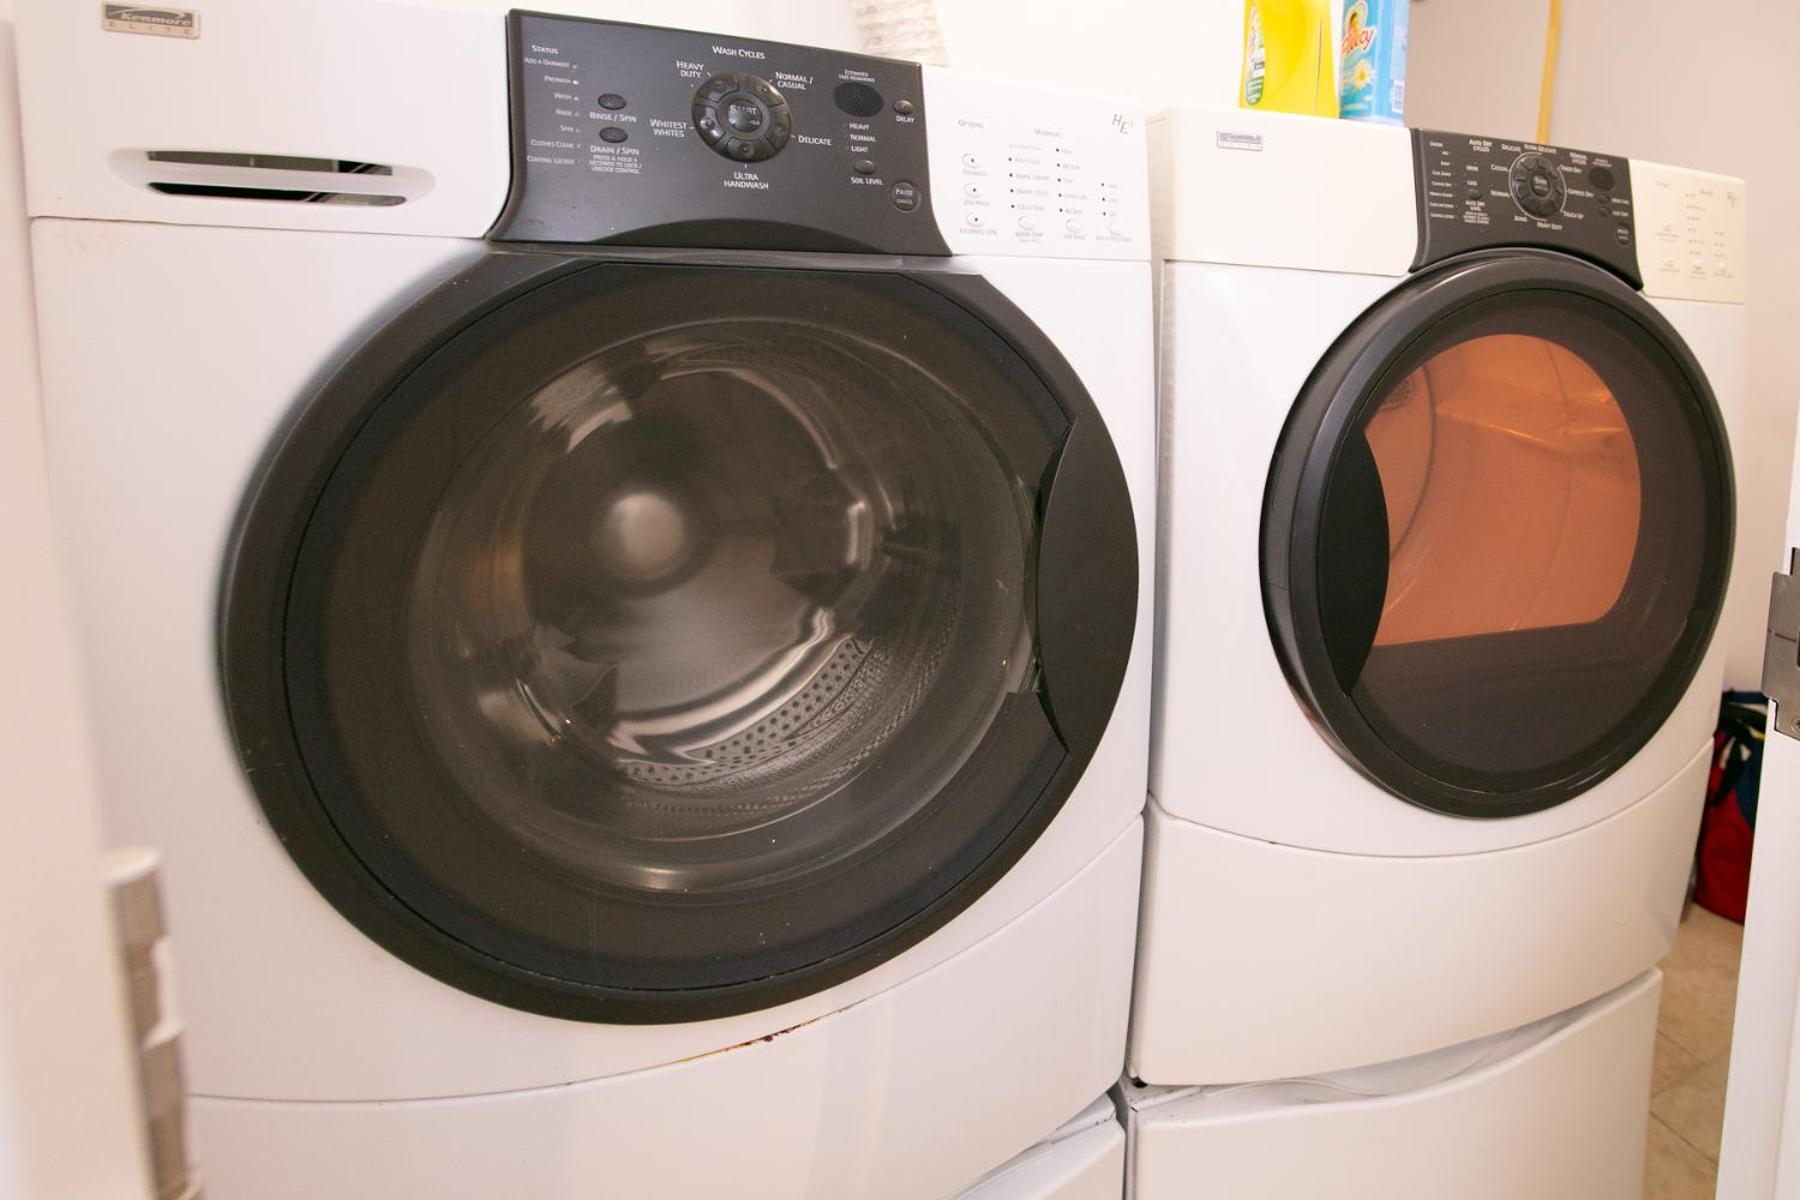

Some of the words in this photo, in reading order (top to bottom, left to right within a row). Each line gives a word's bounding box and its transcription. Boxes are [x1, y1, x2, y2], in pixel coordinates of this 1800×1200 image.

[712, 45, 737, 56] WASH
[738, 48, 766, 59] CYCLES
[676, 60, 704, 71] HEAVY
[681, 70, 702, 79] DUTY
[650, 118, 688, 130] WHITEST
[653, 128, 685, 138] WHITES
[798, 135, 832, 146] DELICATE
